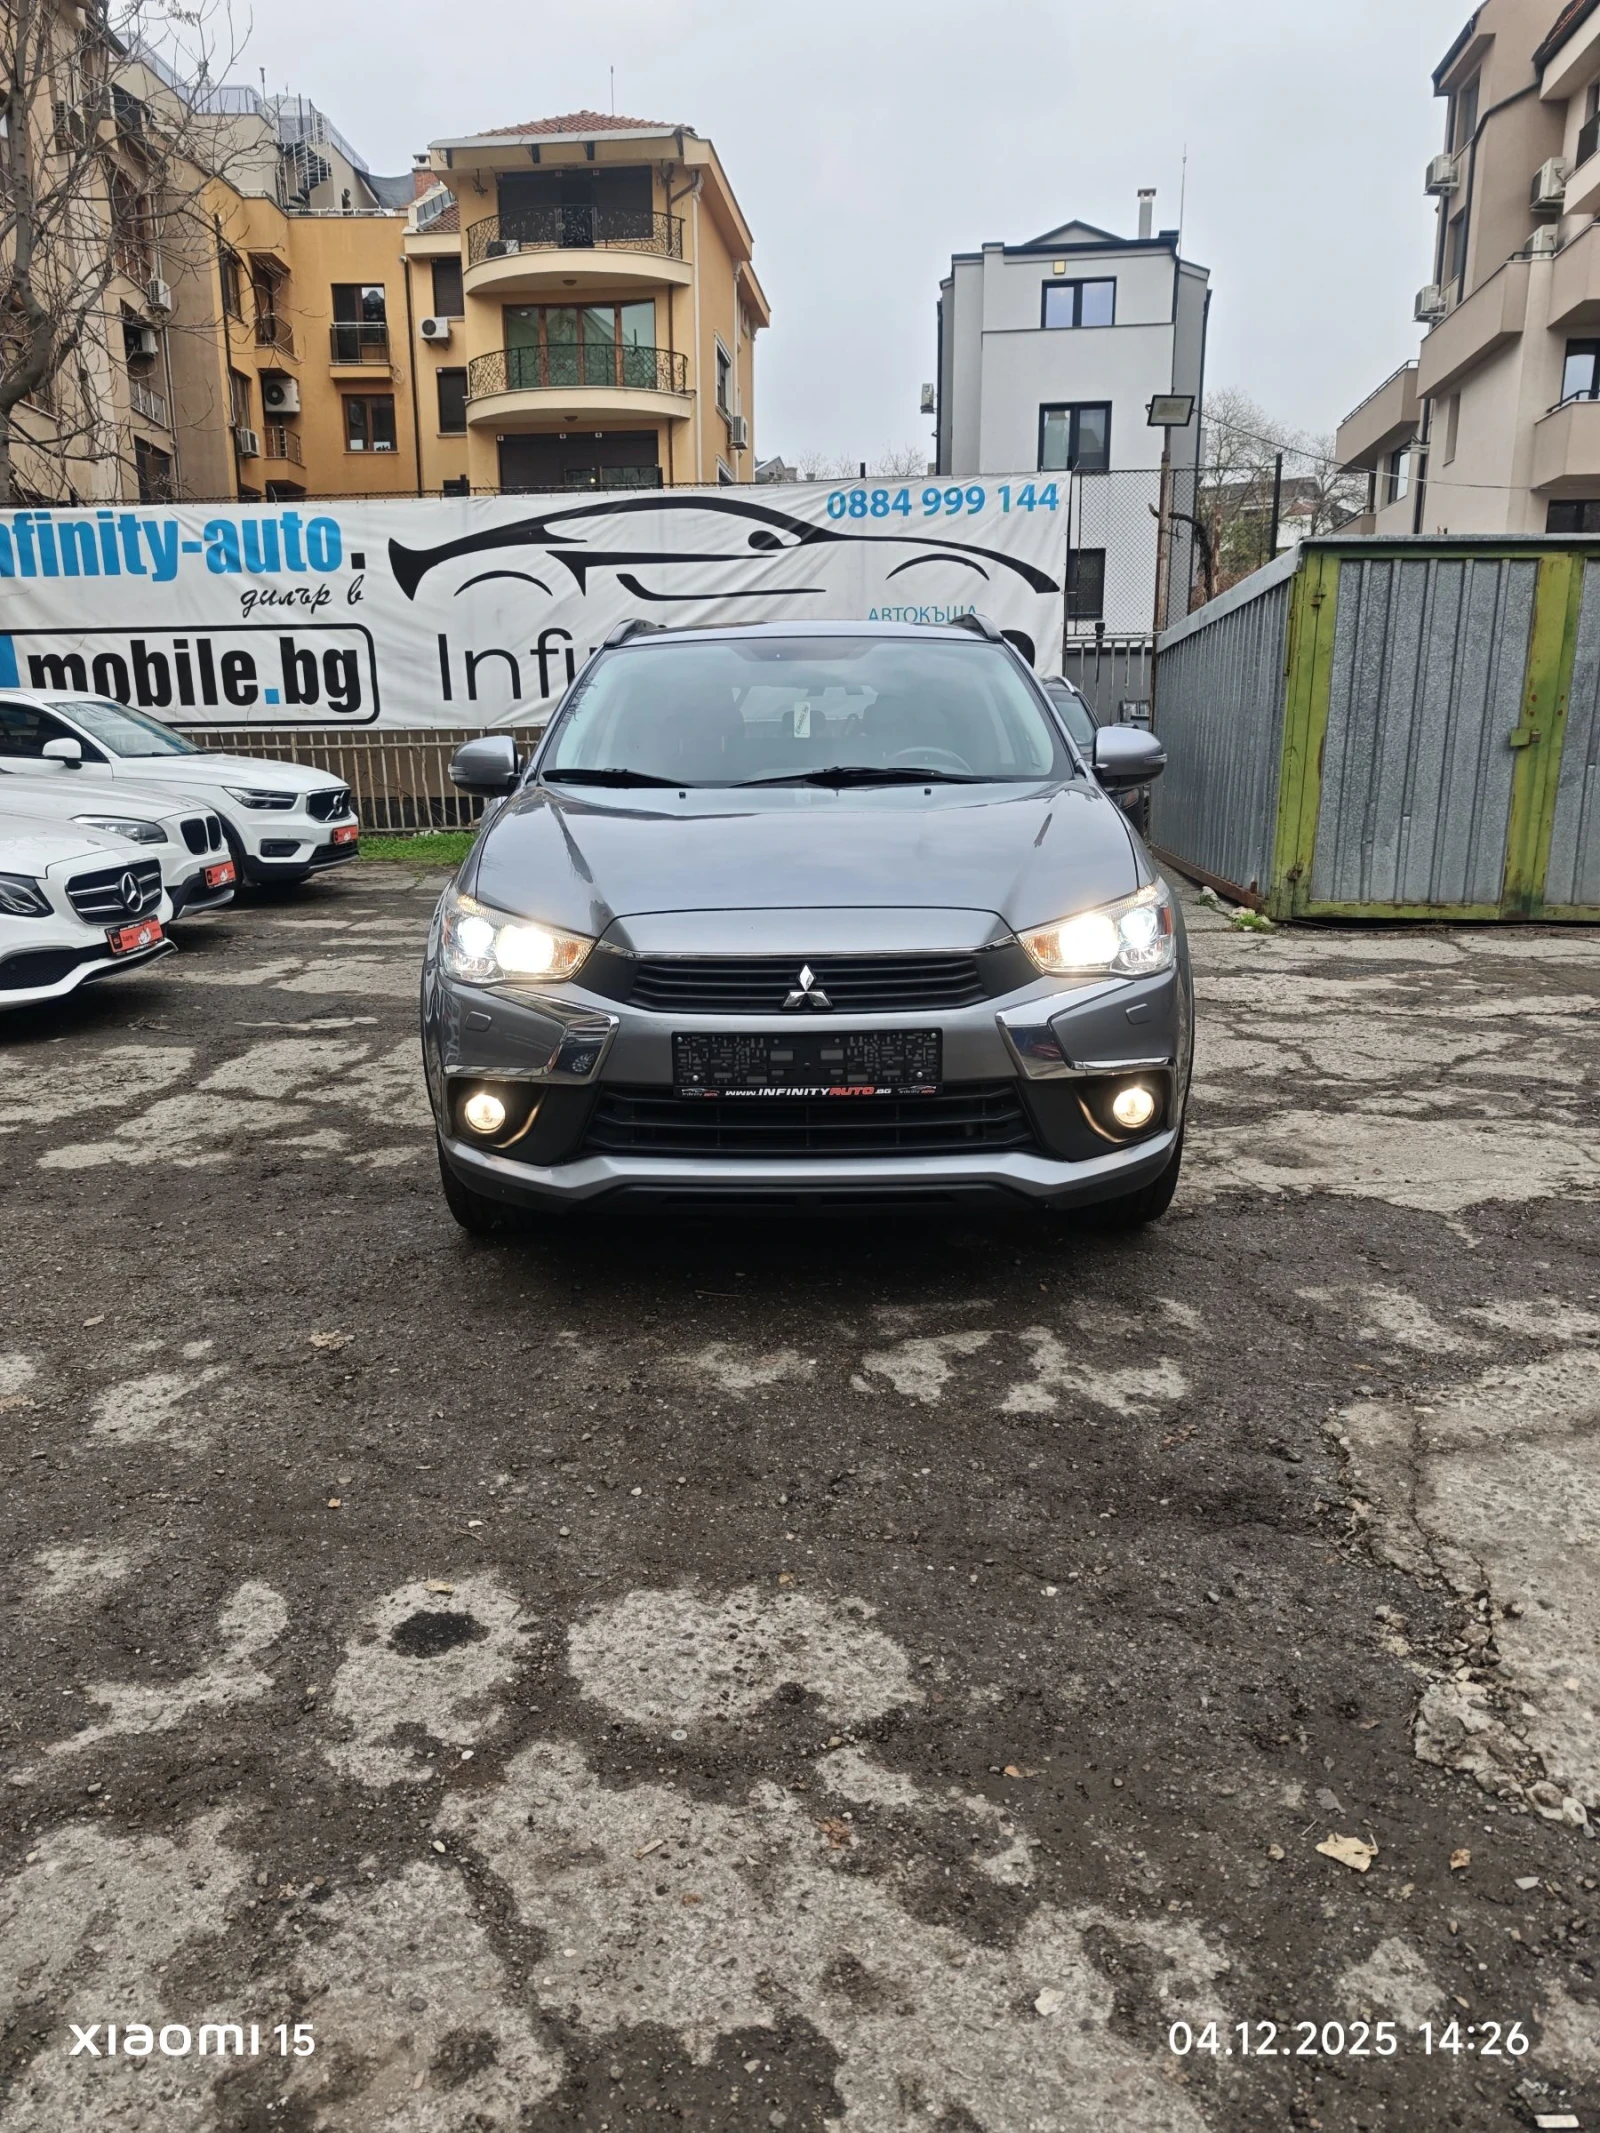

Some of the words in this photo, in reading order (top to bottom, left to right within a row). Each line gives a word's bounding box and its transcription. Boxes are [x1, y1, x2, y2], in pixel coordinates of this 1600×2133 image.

[826, 488, 912, 519] 0884
[922, 486, 985, 516] 999
[997, 483, 1059, 512] 144
[27, 637, 361, 713] mobile.bg
[437, 627, 598, 701] Infi
